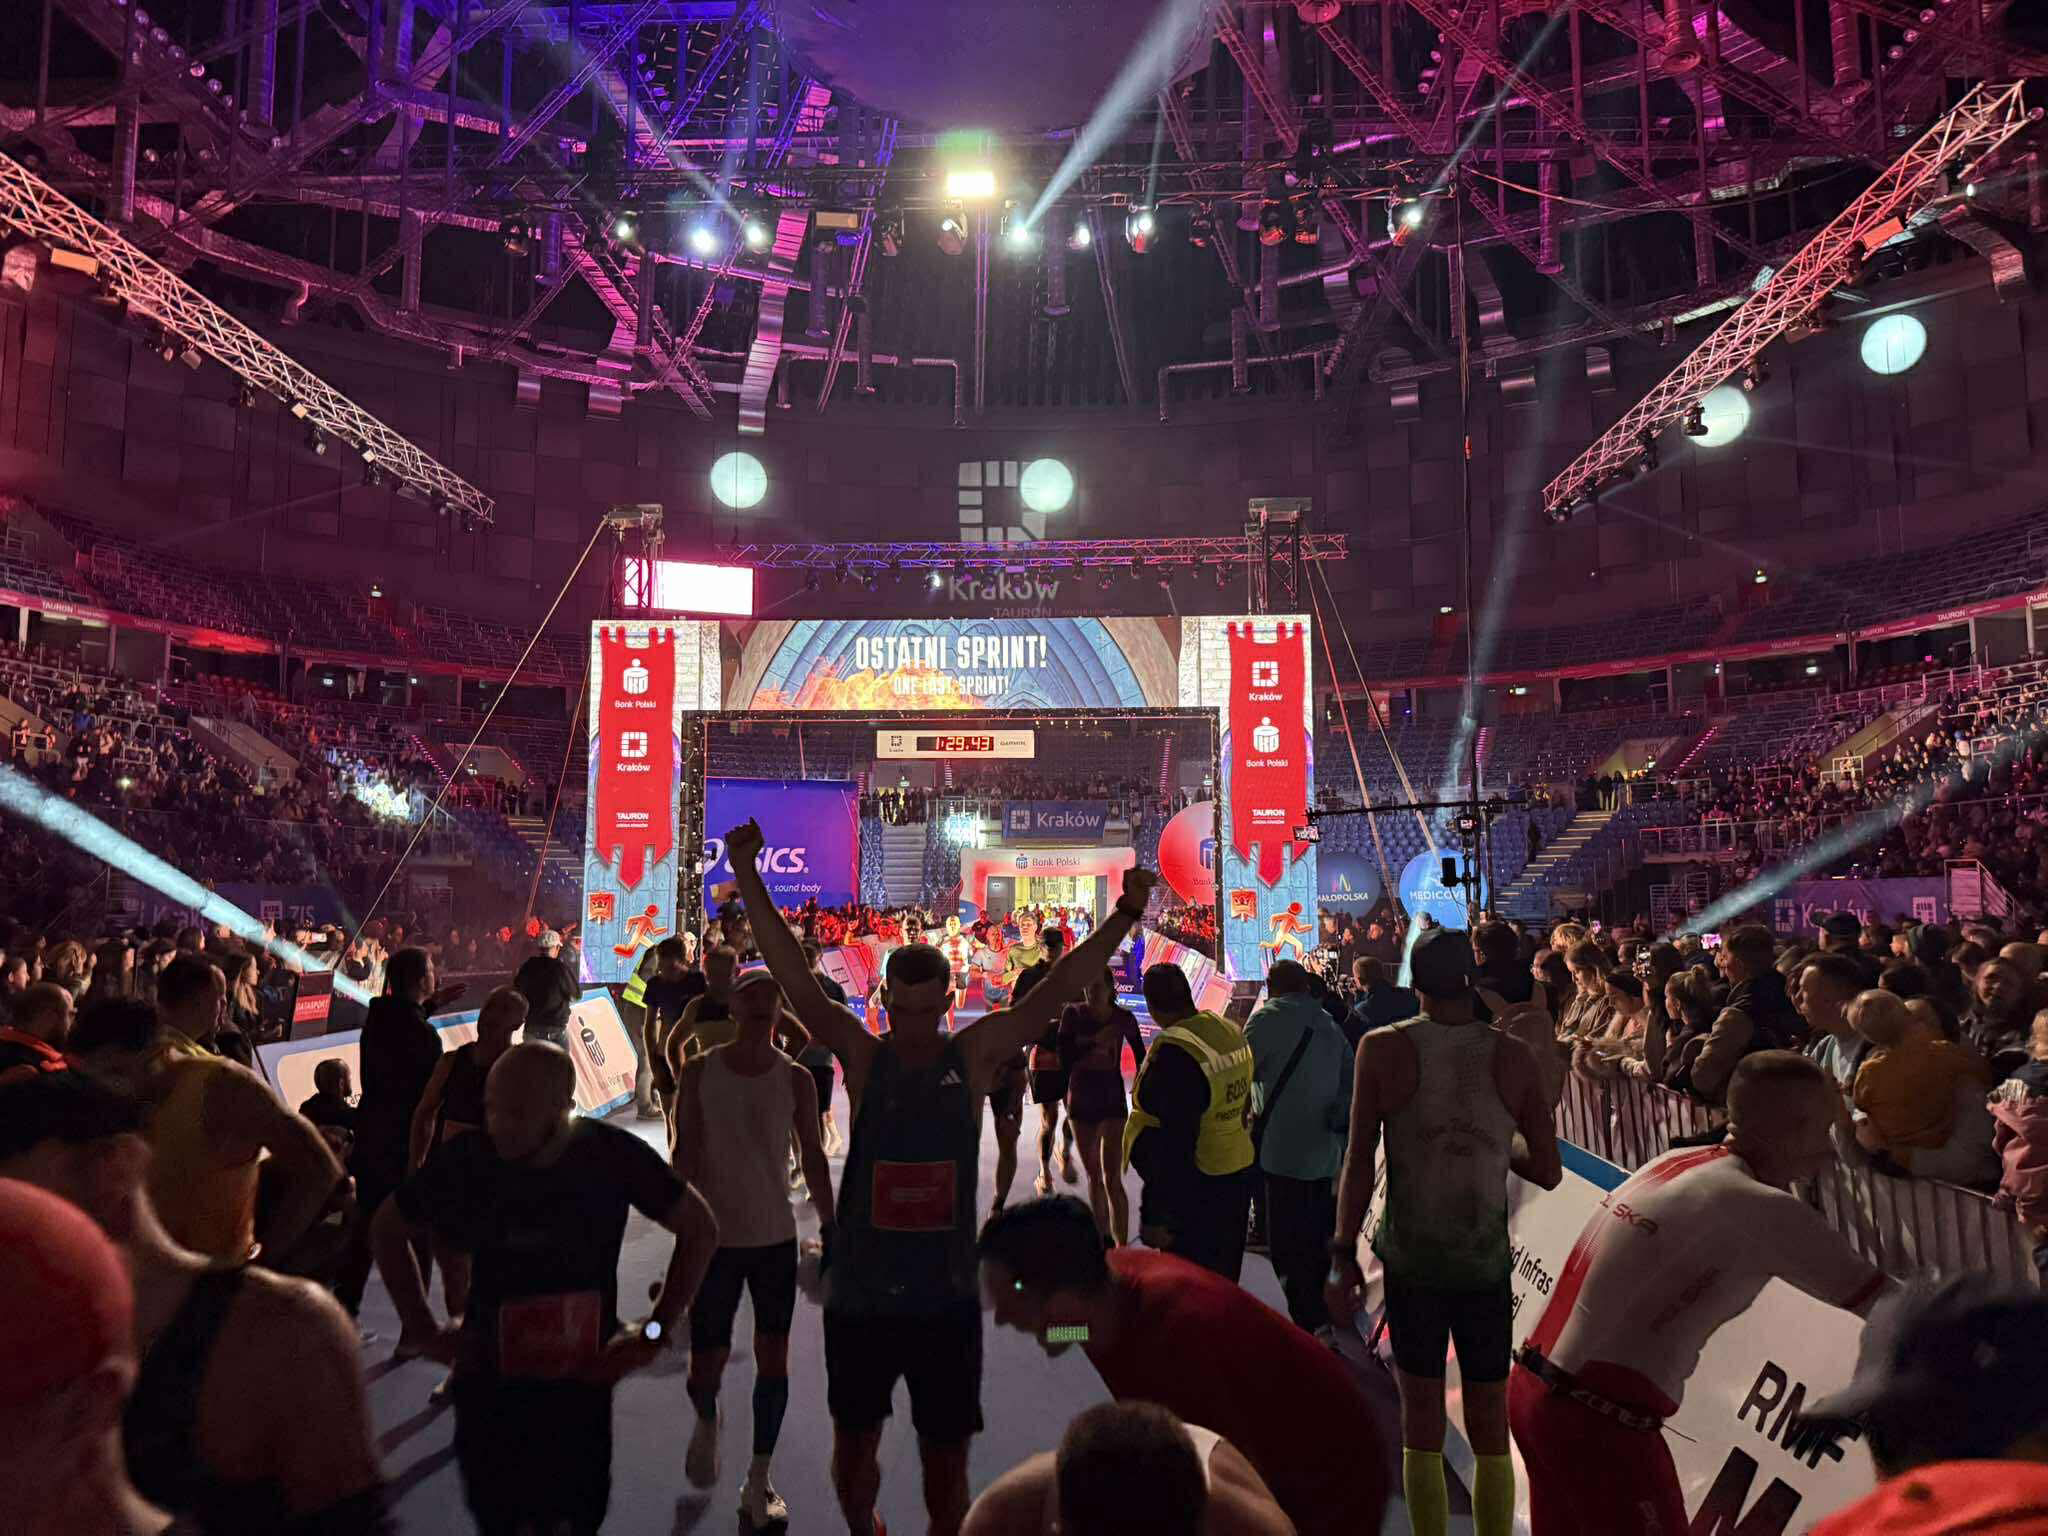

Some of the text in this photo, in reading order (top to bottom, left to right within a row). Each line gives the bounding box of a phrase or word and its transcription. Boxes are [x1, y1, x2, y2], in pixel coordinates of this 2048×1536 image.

[1937, 610, 1966, 622] TAURON
[855, 635, 1047, 669] OSTATNI SPRINT!
[894, 674, 1010, 695] ONE LAST SPRINT!
[1248, 692, 1283, 702] Kraków
[615, 700, 657, 709] Bank Polski
[616, 762, 651, 772] Kraków
[1246, 759, 1288, 768] Bank Polski
[616, 811, 649, 820] TAURON
[1252, 809, 1285, 817] TAURON
[1036, 811, 1100, 828] Kraków
[1032, 856, 1080, 867] Bank Polski
[773, 882, 799, 893] sound
[801, 881, 822, 896] body
[1409, 889, 1467, 901] MEDICOVE
